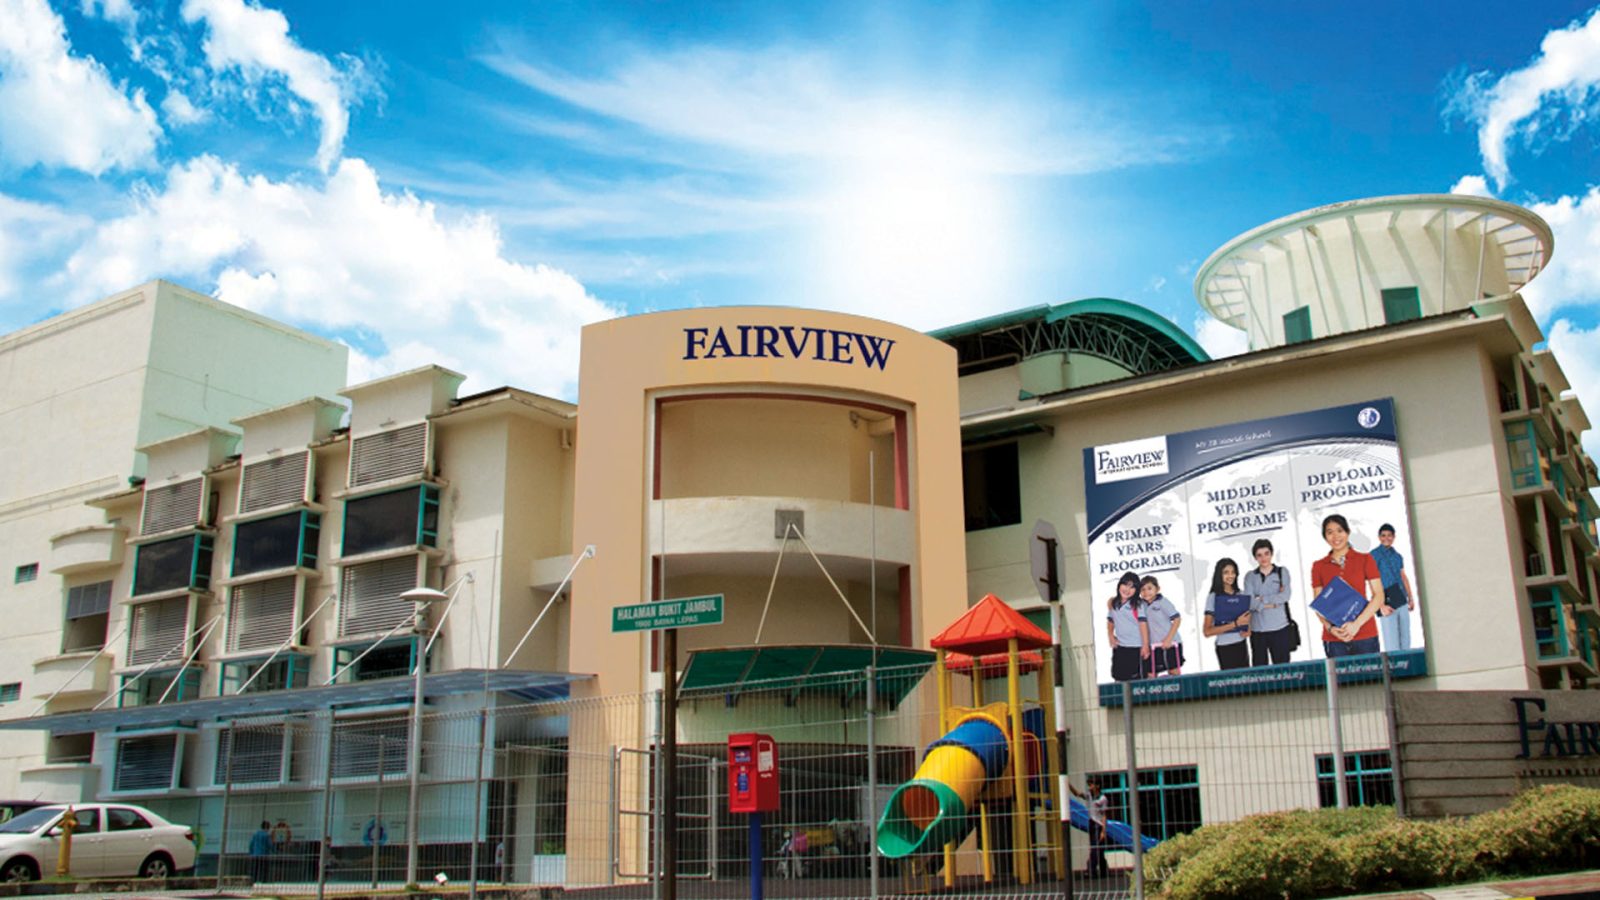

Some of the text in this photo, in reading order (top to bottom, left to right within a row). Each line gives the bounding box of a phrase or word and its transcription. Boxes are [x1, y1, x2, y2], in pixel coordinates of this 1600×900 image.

[682, 325, 896, 371] FAIRVIEW
[1097, 450, 1165, 471] FAIRVIEW
[1142, 461, 1164, 469] SCHOOL
[1307, 465, 1385, 487] DIPLOMA
[1207, 482, 1272, 503] MIDDLE
[1301, 479, 1395, 503] PROGRAME
[1215, 499, 1266, 517] YEARS
[1105, 523, 1172, 543] PRIMARY
[1197, 511, 1288, 535] PROGRAME
[1116, 540, 1164, 556] YEARS
[1099, 552, 1183, 575] PROGRAME
[617, 599, 717, 621] HALAMAN BUKIT JAMBUL
[677, 615, 698, 625] LEPAS
